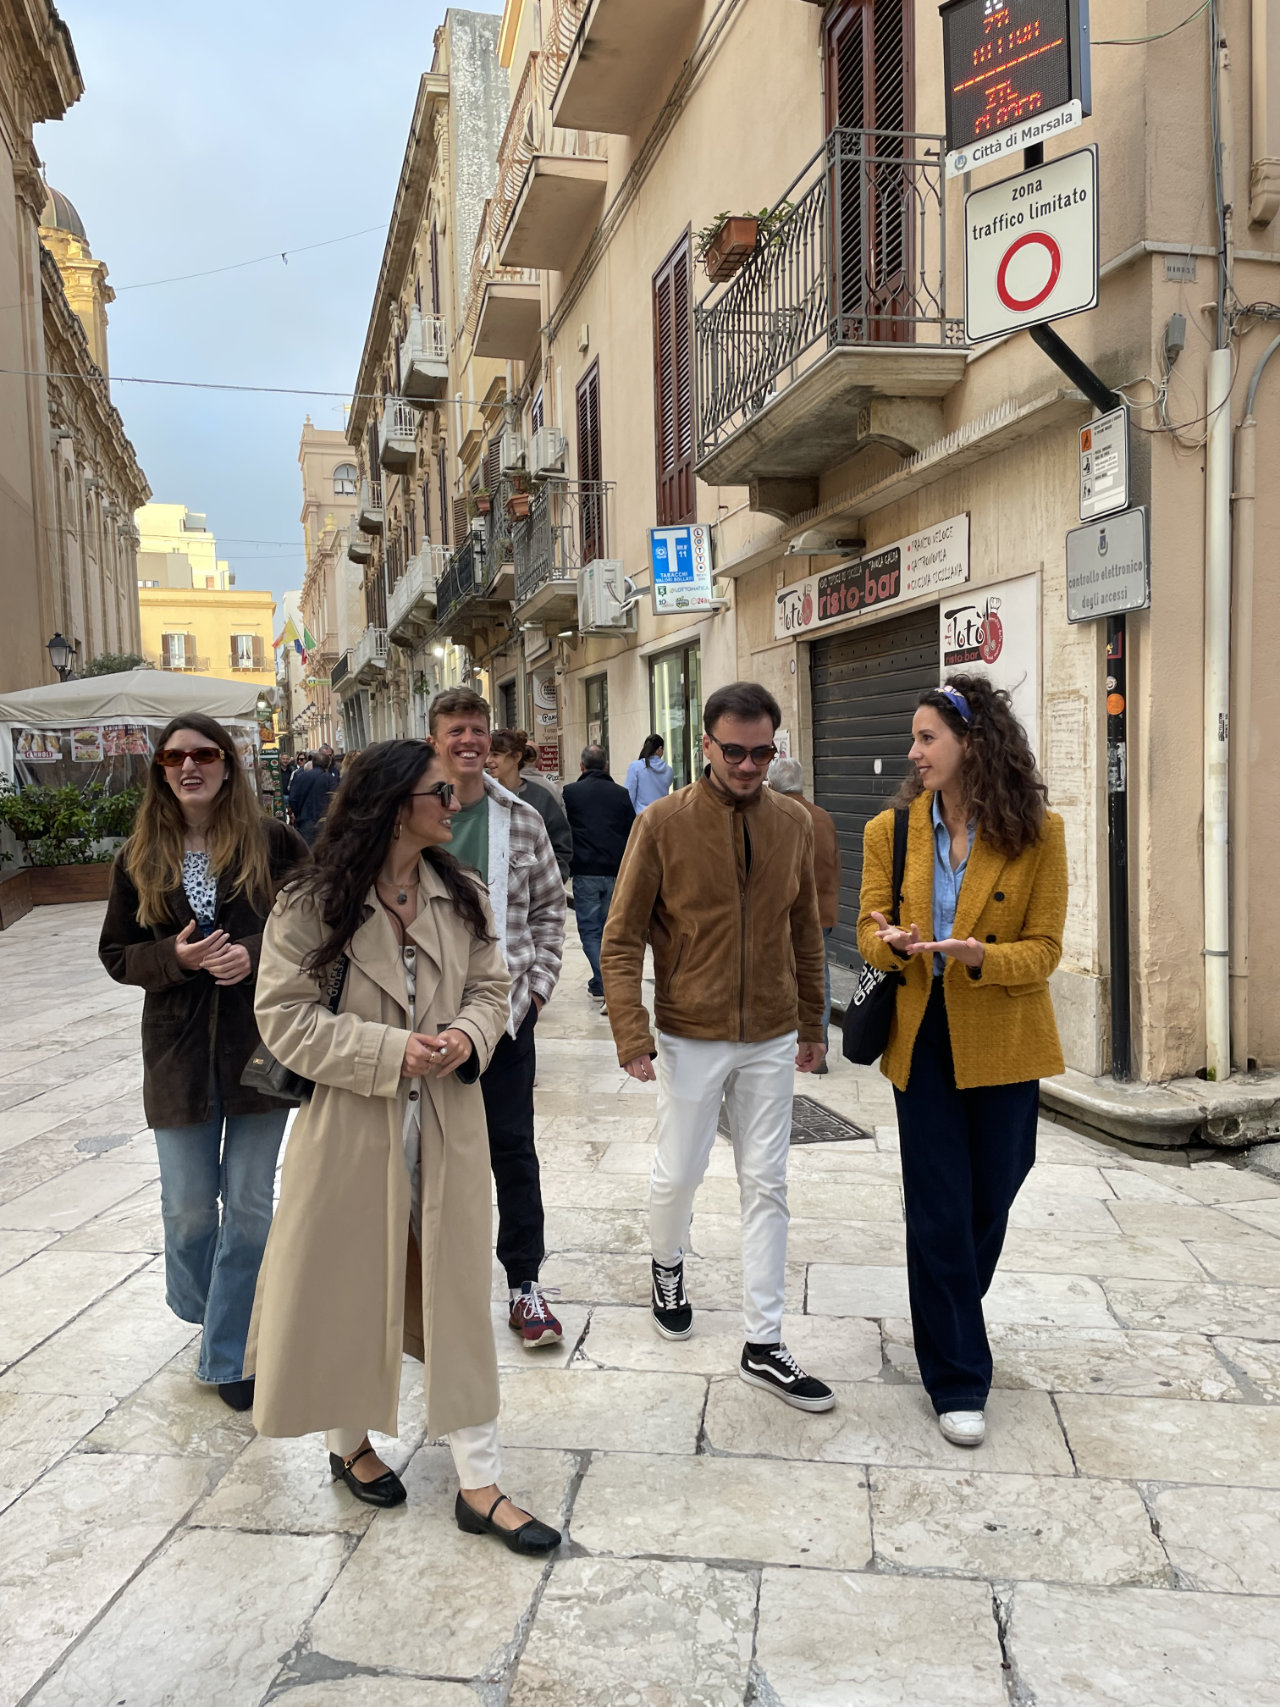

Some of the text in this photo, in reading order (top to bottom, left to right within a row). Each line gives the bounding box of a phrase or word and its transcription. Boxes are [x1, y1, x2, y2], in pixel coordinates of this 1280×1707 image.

[972, 139, 1002, 162] Città
[1005, 133, 1017, 148] di
[1021, 113, 1073, 142] Marsala
[1011, 179, 1043, 201] zona
[972, 187, 1087, 240] traffico limitato
[653, 529, 688, 572] T
[819, 568, 899, 618] risto-bar
[1068, 560, 1143, 589] controllo elettronico
[1081, 586, 1128, 610] degli accessi
